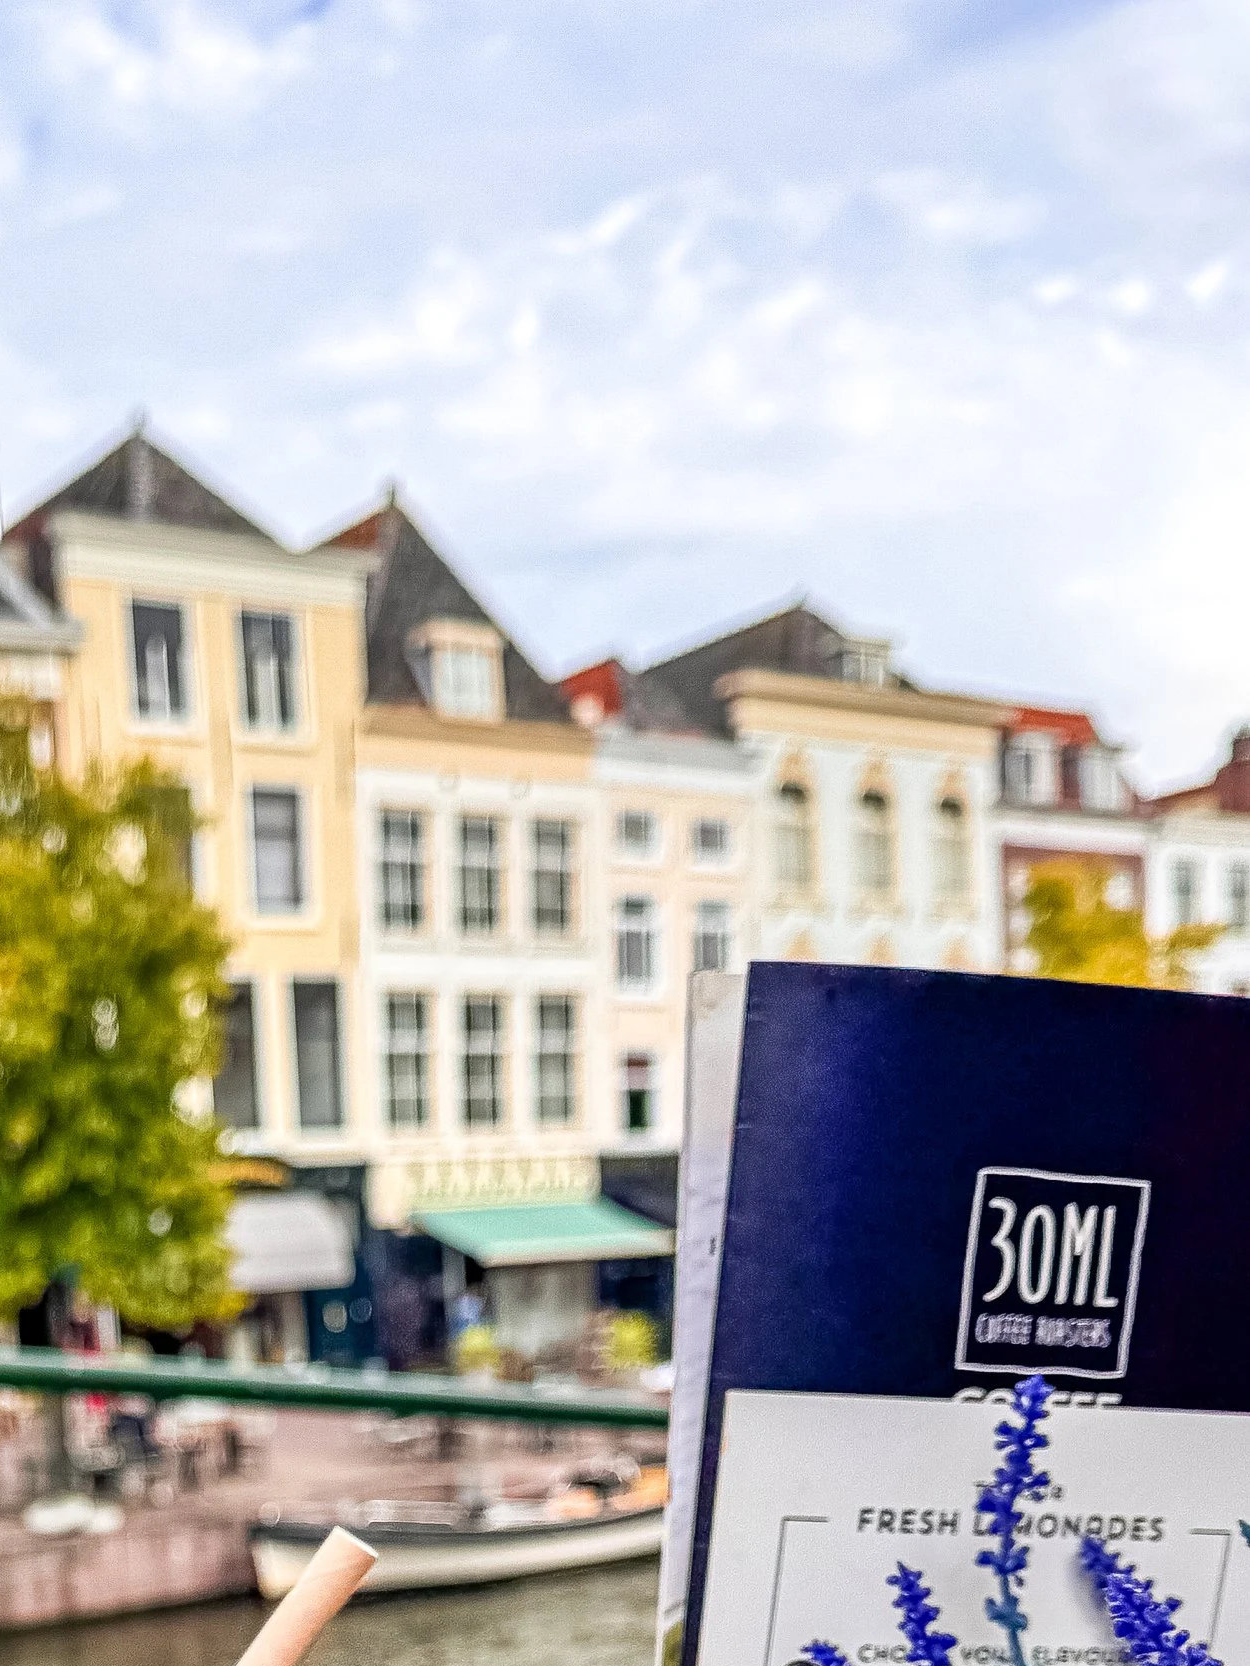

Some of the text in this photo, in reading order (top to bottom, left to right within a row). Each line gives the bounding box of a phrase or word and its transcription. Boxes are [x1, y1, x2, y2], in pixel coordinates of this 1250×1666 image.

[982, 1196, 1119, 1307] 30ML
[856, 1508, 1164, 1542] FRESH LMONADES
